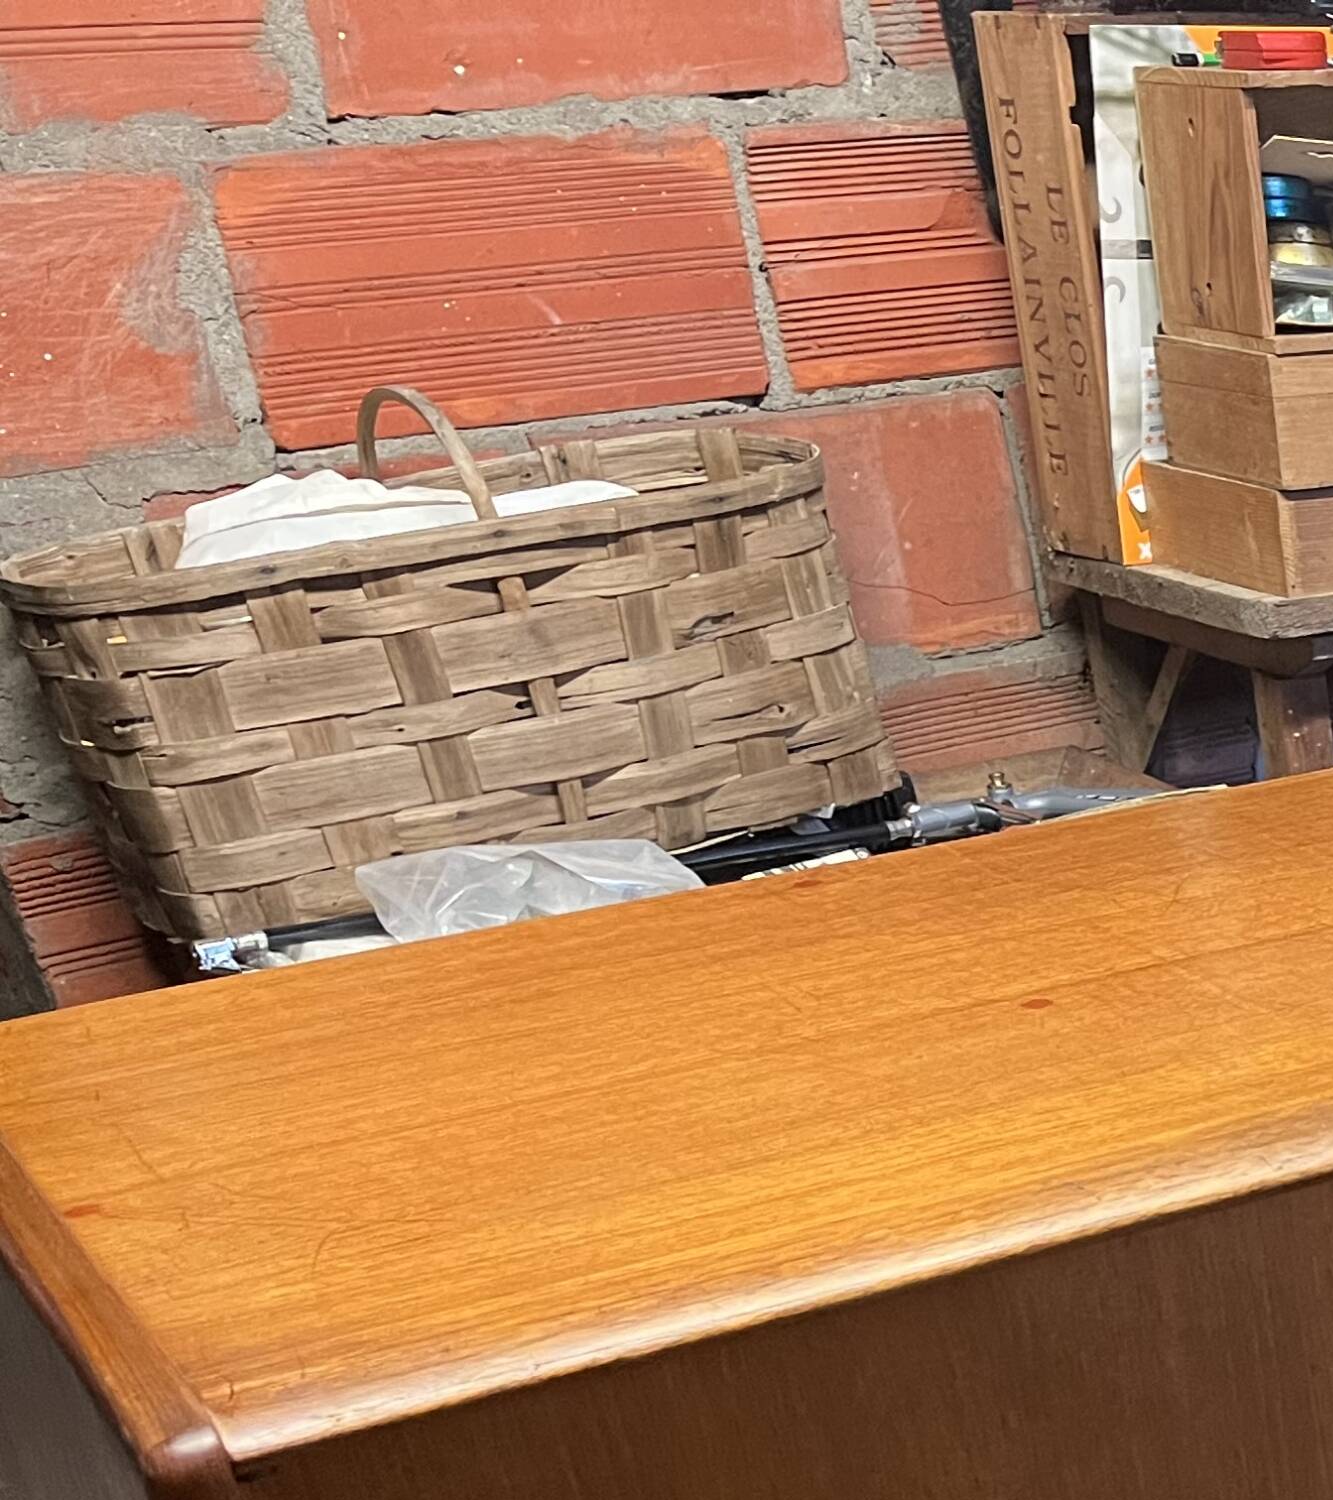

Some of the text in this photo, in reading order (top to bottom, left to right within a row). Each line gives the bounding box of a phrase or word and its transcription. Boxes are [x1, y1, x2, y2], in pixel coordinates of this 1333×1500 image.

[998, 96, 1070, 478] FOLLAINVILLE
[1045, 185, 1092, 399] LE CLOS
